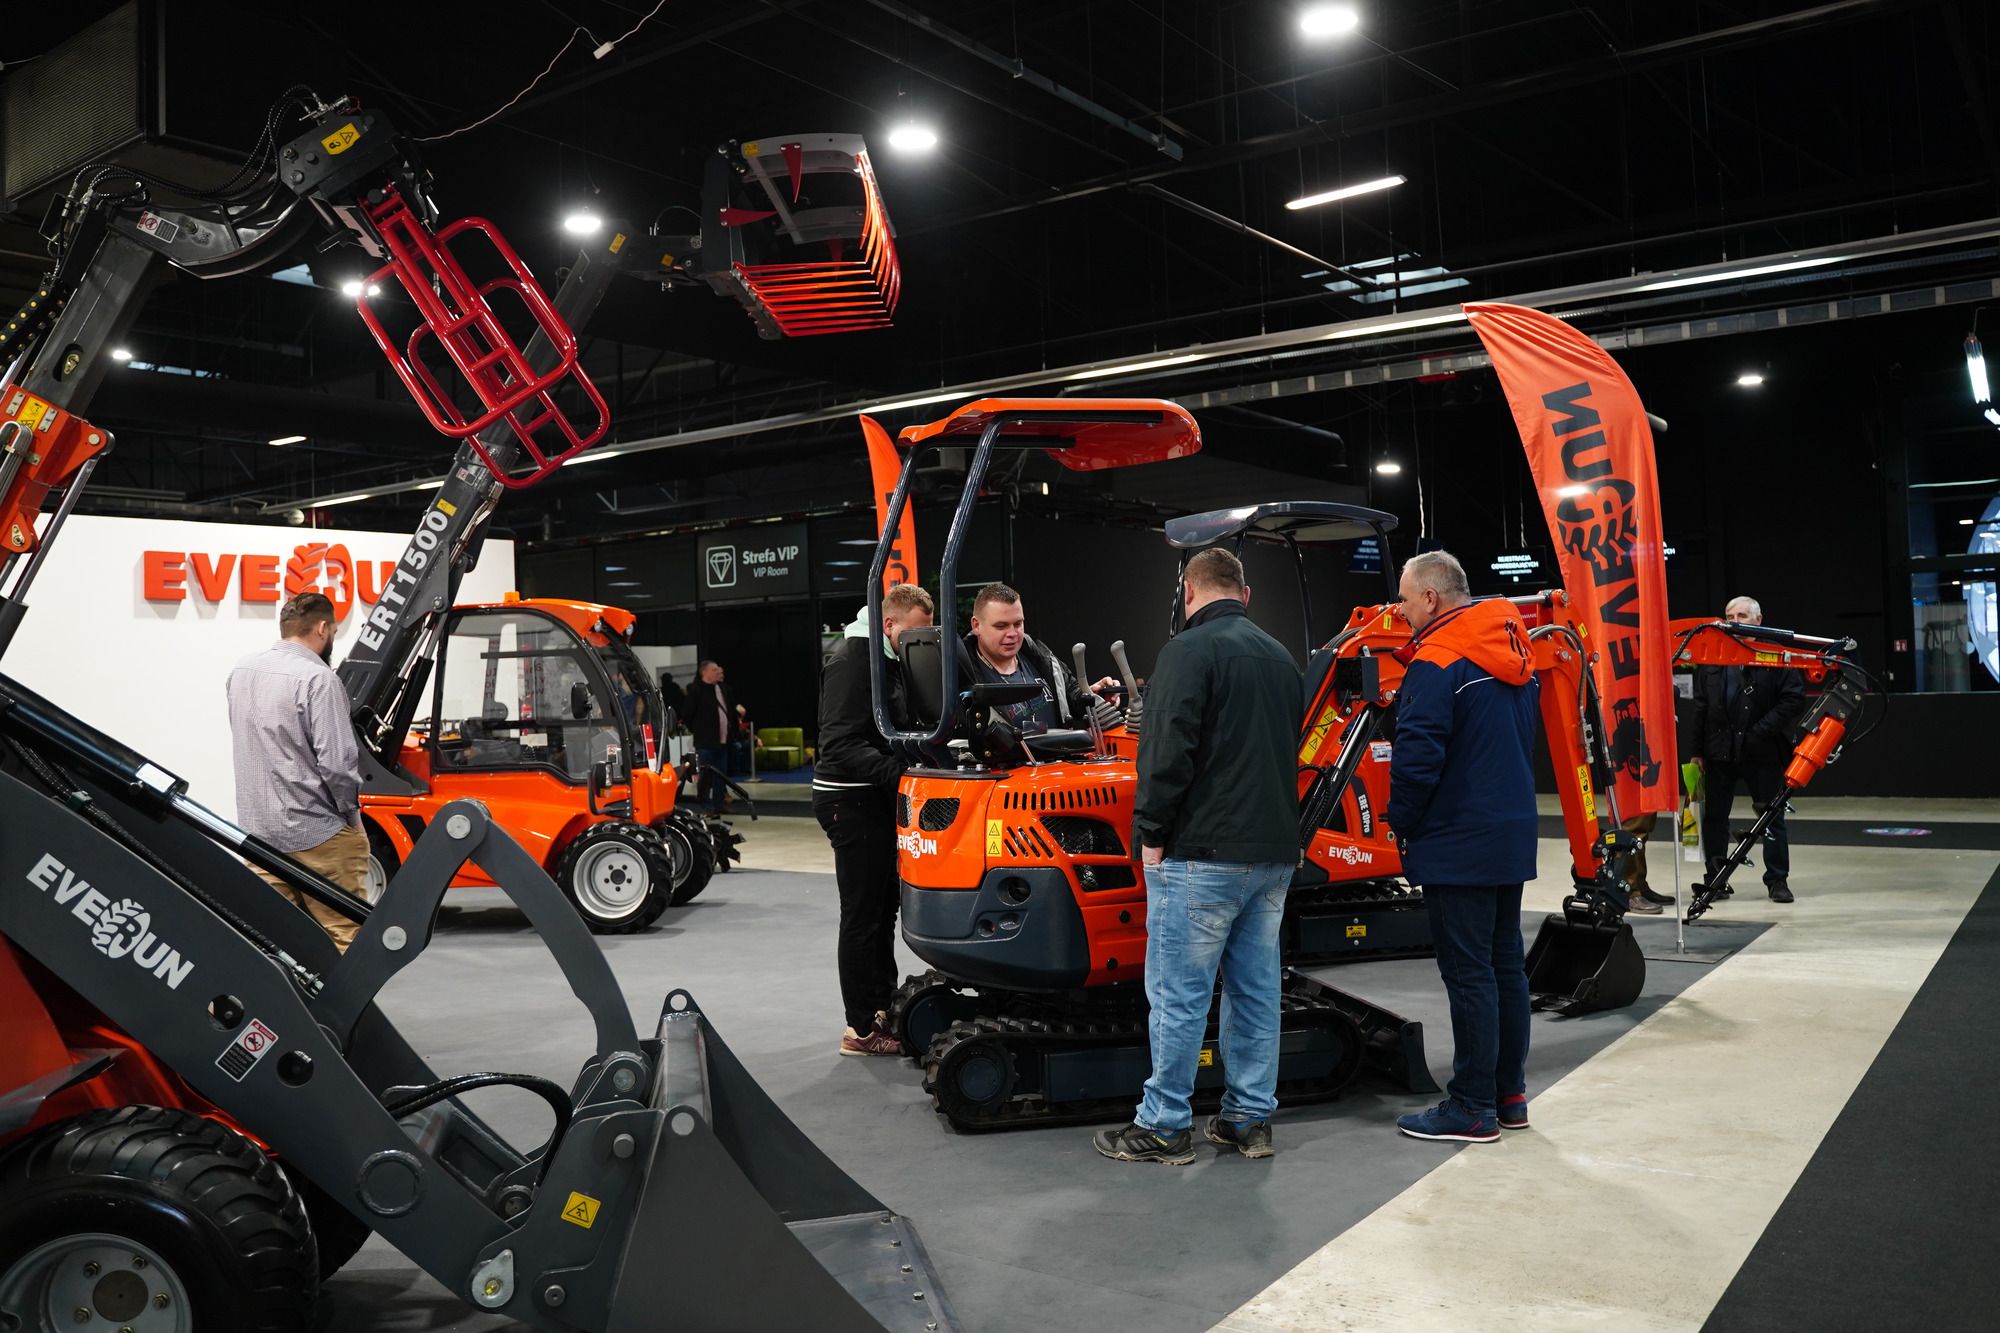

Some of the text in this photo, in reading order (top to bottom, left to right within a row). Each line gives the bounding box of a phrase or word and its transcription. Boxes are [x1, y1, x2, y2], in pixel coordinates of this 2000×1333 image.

[742, 545, 799, 565] Strefa VIP
[1541, 382, 1640, 680] EVERUN
[143, 542, 397, 623] EVERU
[359, 510, 448, 652] ERT1500
[753, 566, 789, 578] VIP Room
[897, 831, 937, 859] EVERUN
[1328, 845, 1373, 865] EVERUN
[26, 852, 195, 990] EVERUN
